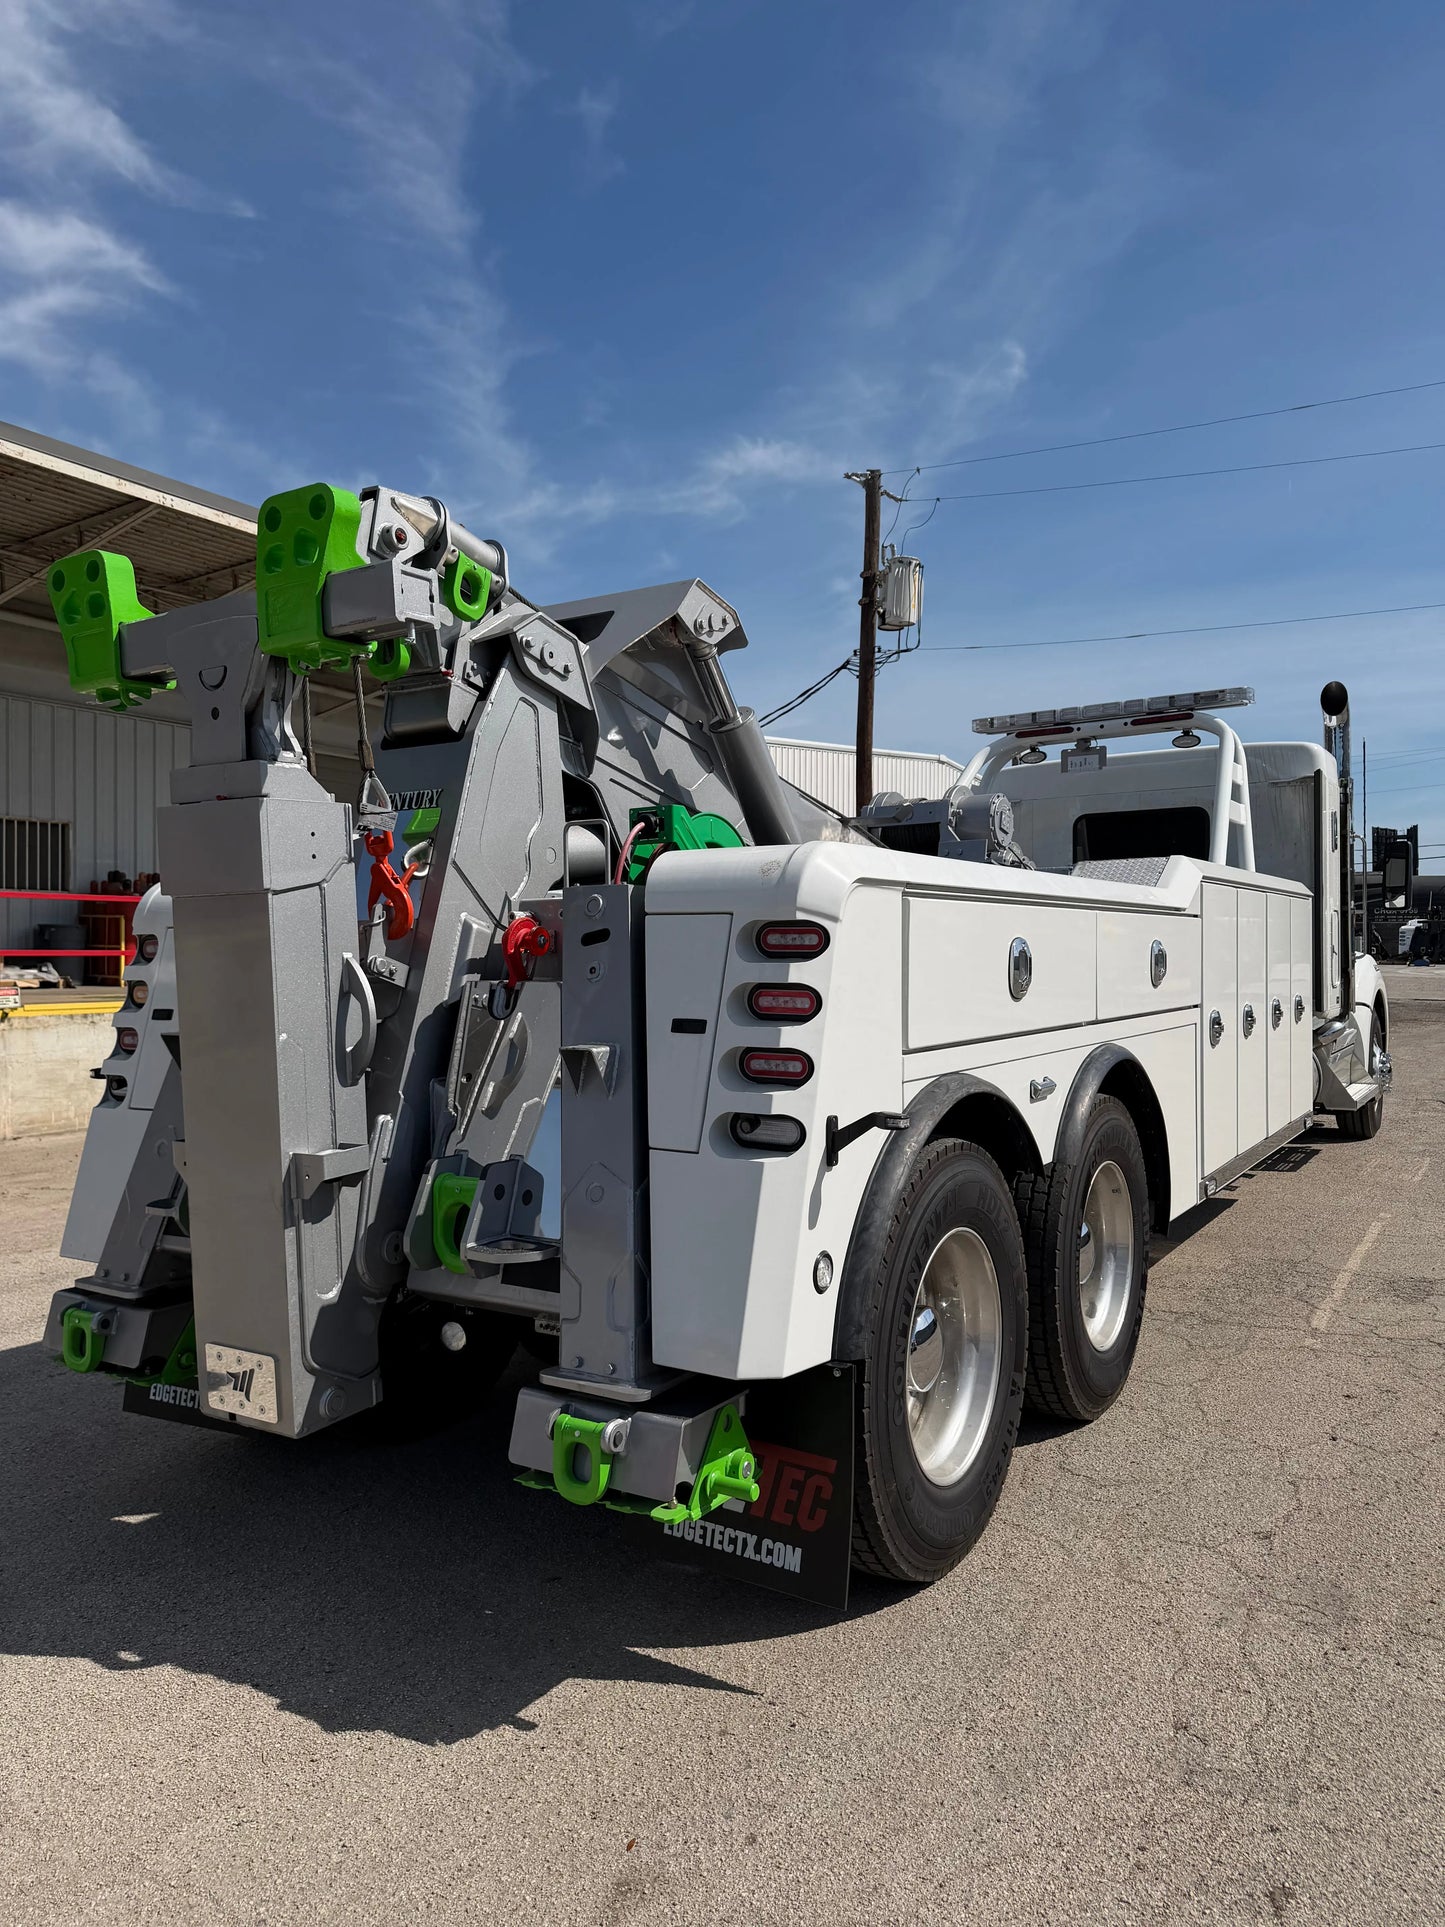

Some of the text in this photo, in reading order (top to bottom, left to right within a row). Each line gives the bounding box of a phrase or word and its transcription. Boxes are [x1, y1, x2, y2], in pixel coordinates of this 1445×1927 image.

[388, 789, 441, 811] NTURY
[891, 1186, 959, 1428] CONTINENTAL
[663, 1519, 802, 1573] EDGETECTX.COM
